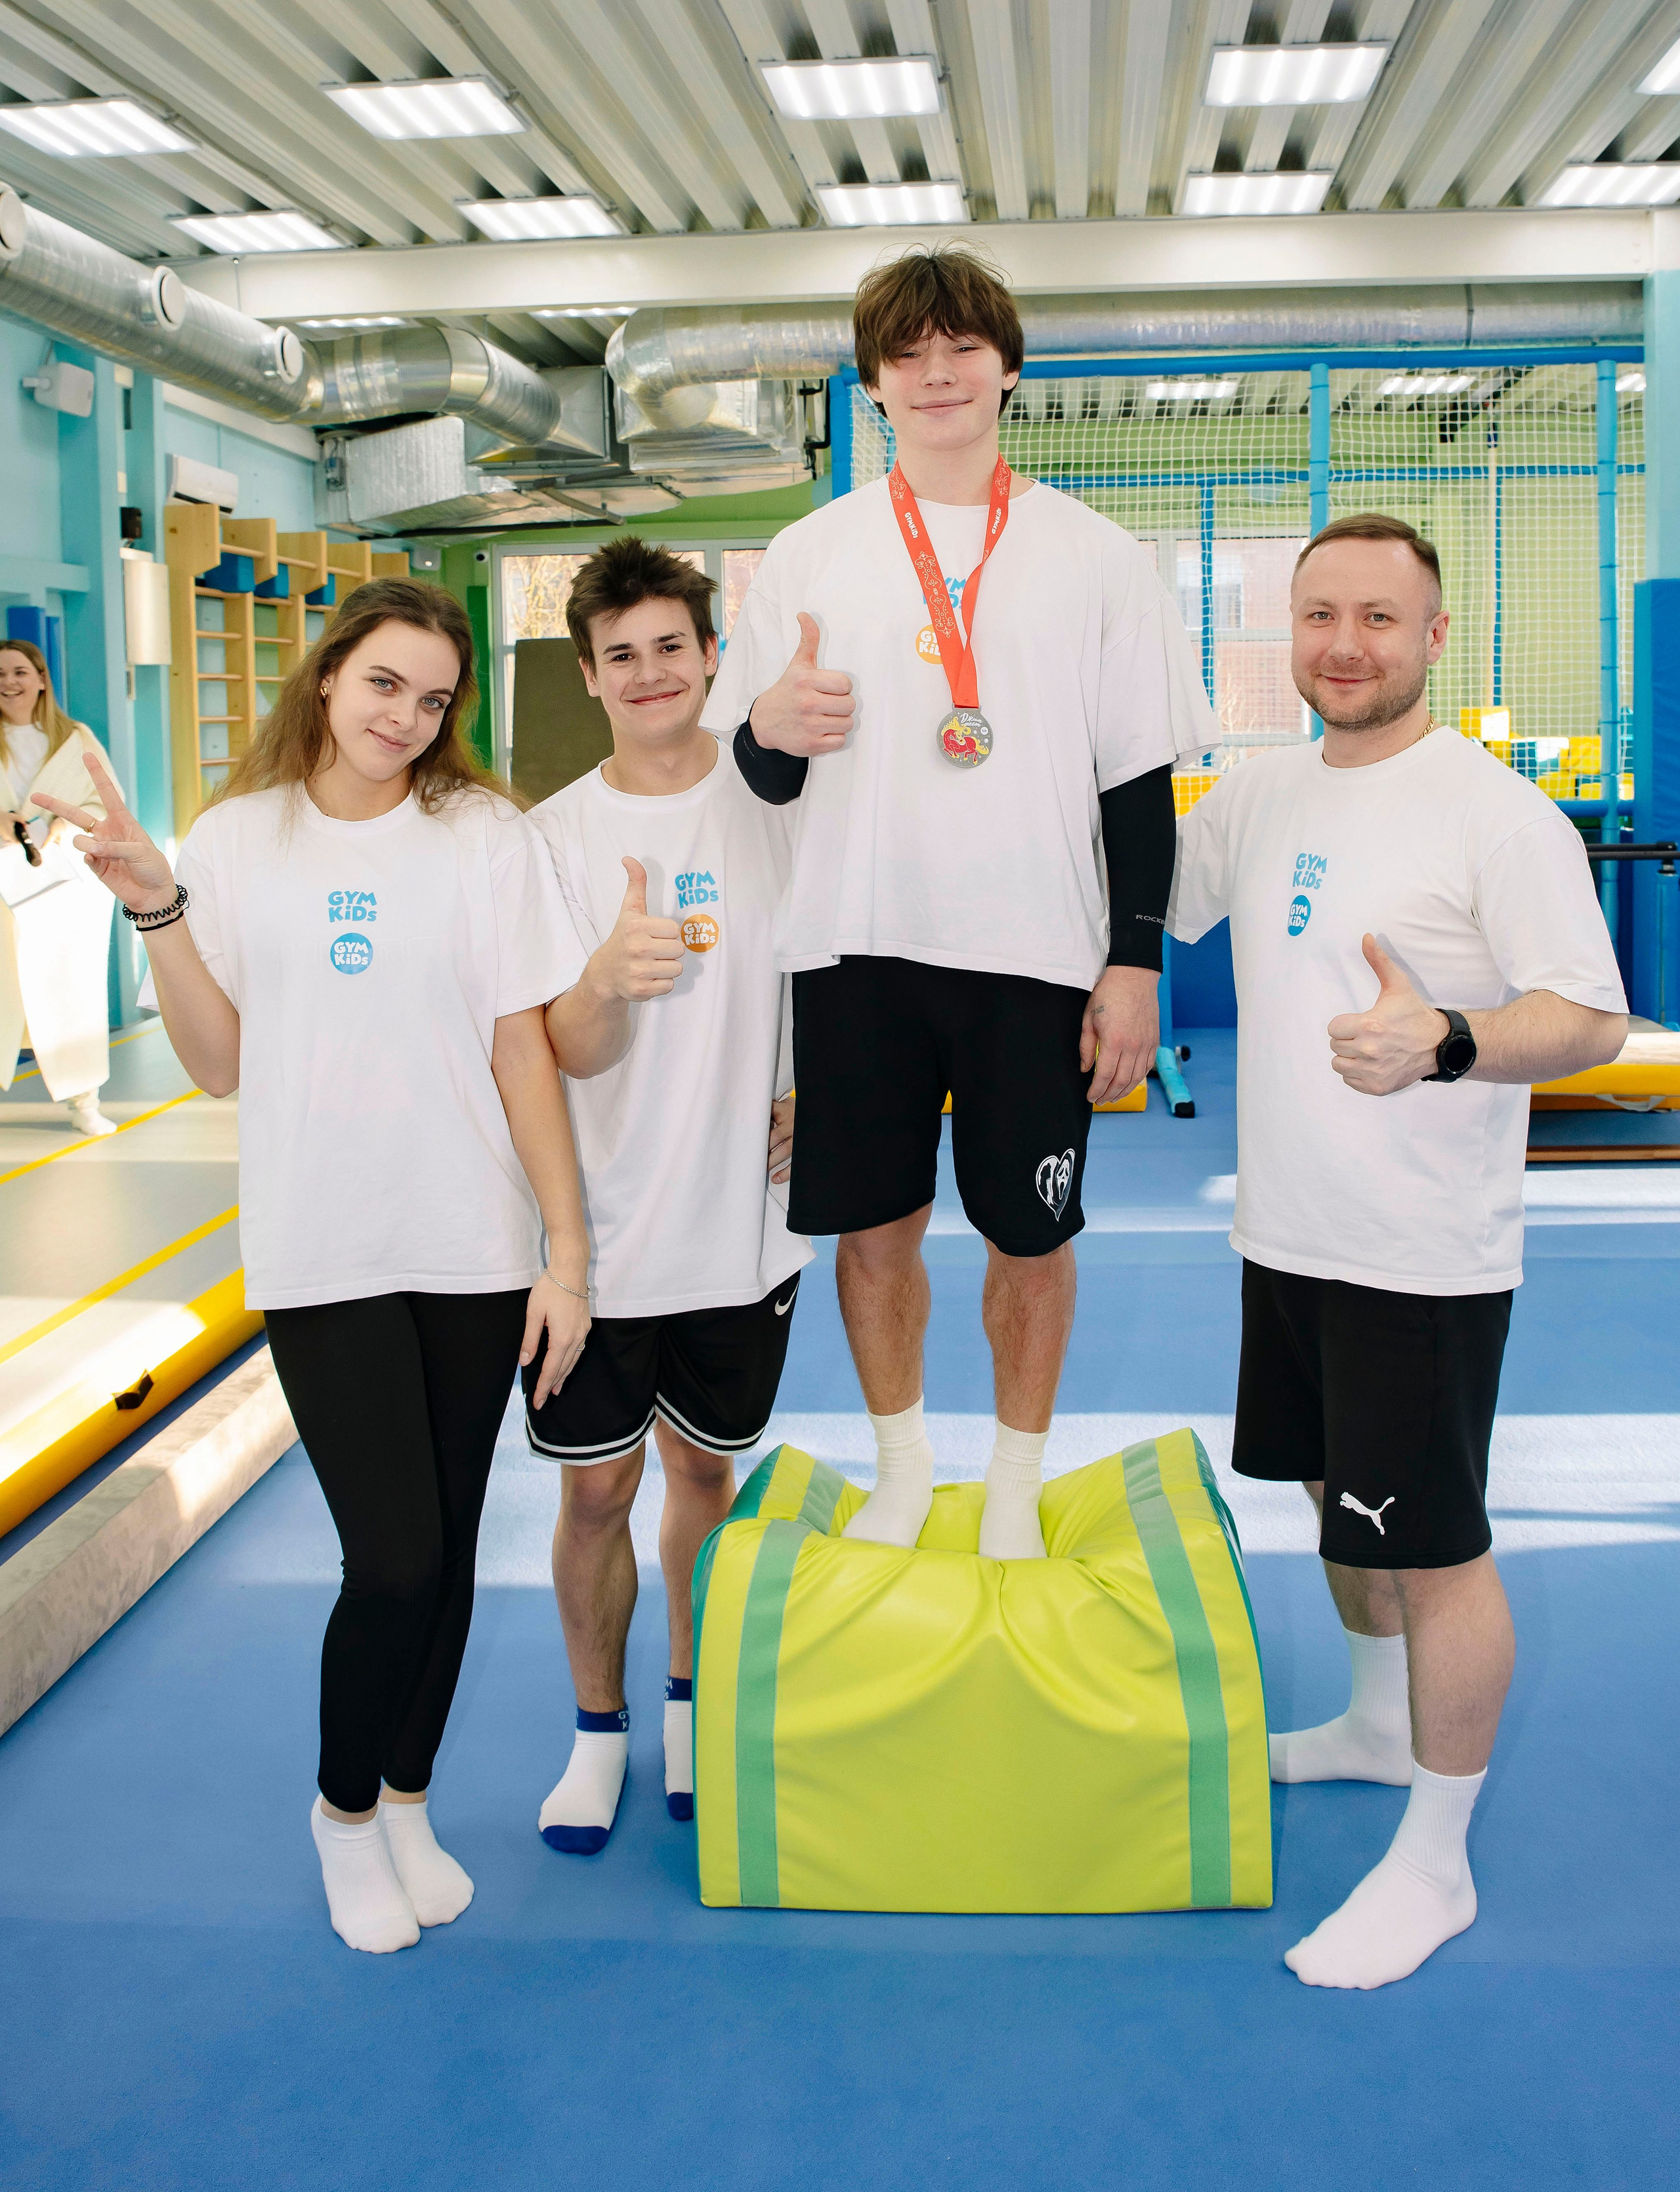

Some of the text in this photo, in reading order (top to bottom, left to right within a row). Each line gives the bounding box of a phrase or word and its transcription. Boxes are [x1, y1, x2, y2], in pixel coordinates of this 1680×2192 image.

[920, 630, 938, 644] GY
[1295, 853, 1328, 874] GYM
[675, 870, 716, 891] GYM
[328, 891, 377, 906] GYM
[1290, 904, 1307, 917] GYM
[1135, 914, 1165, 925] ROCKB
[683, 922, 715, 935] GYM
[334, 941, 369, 954] GYM
